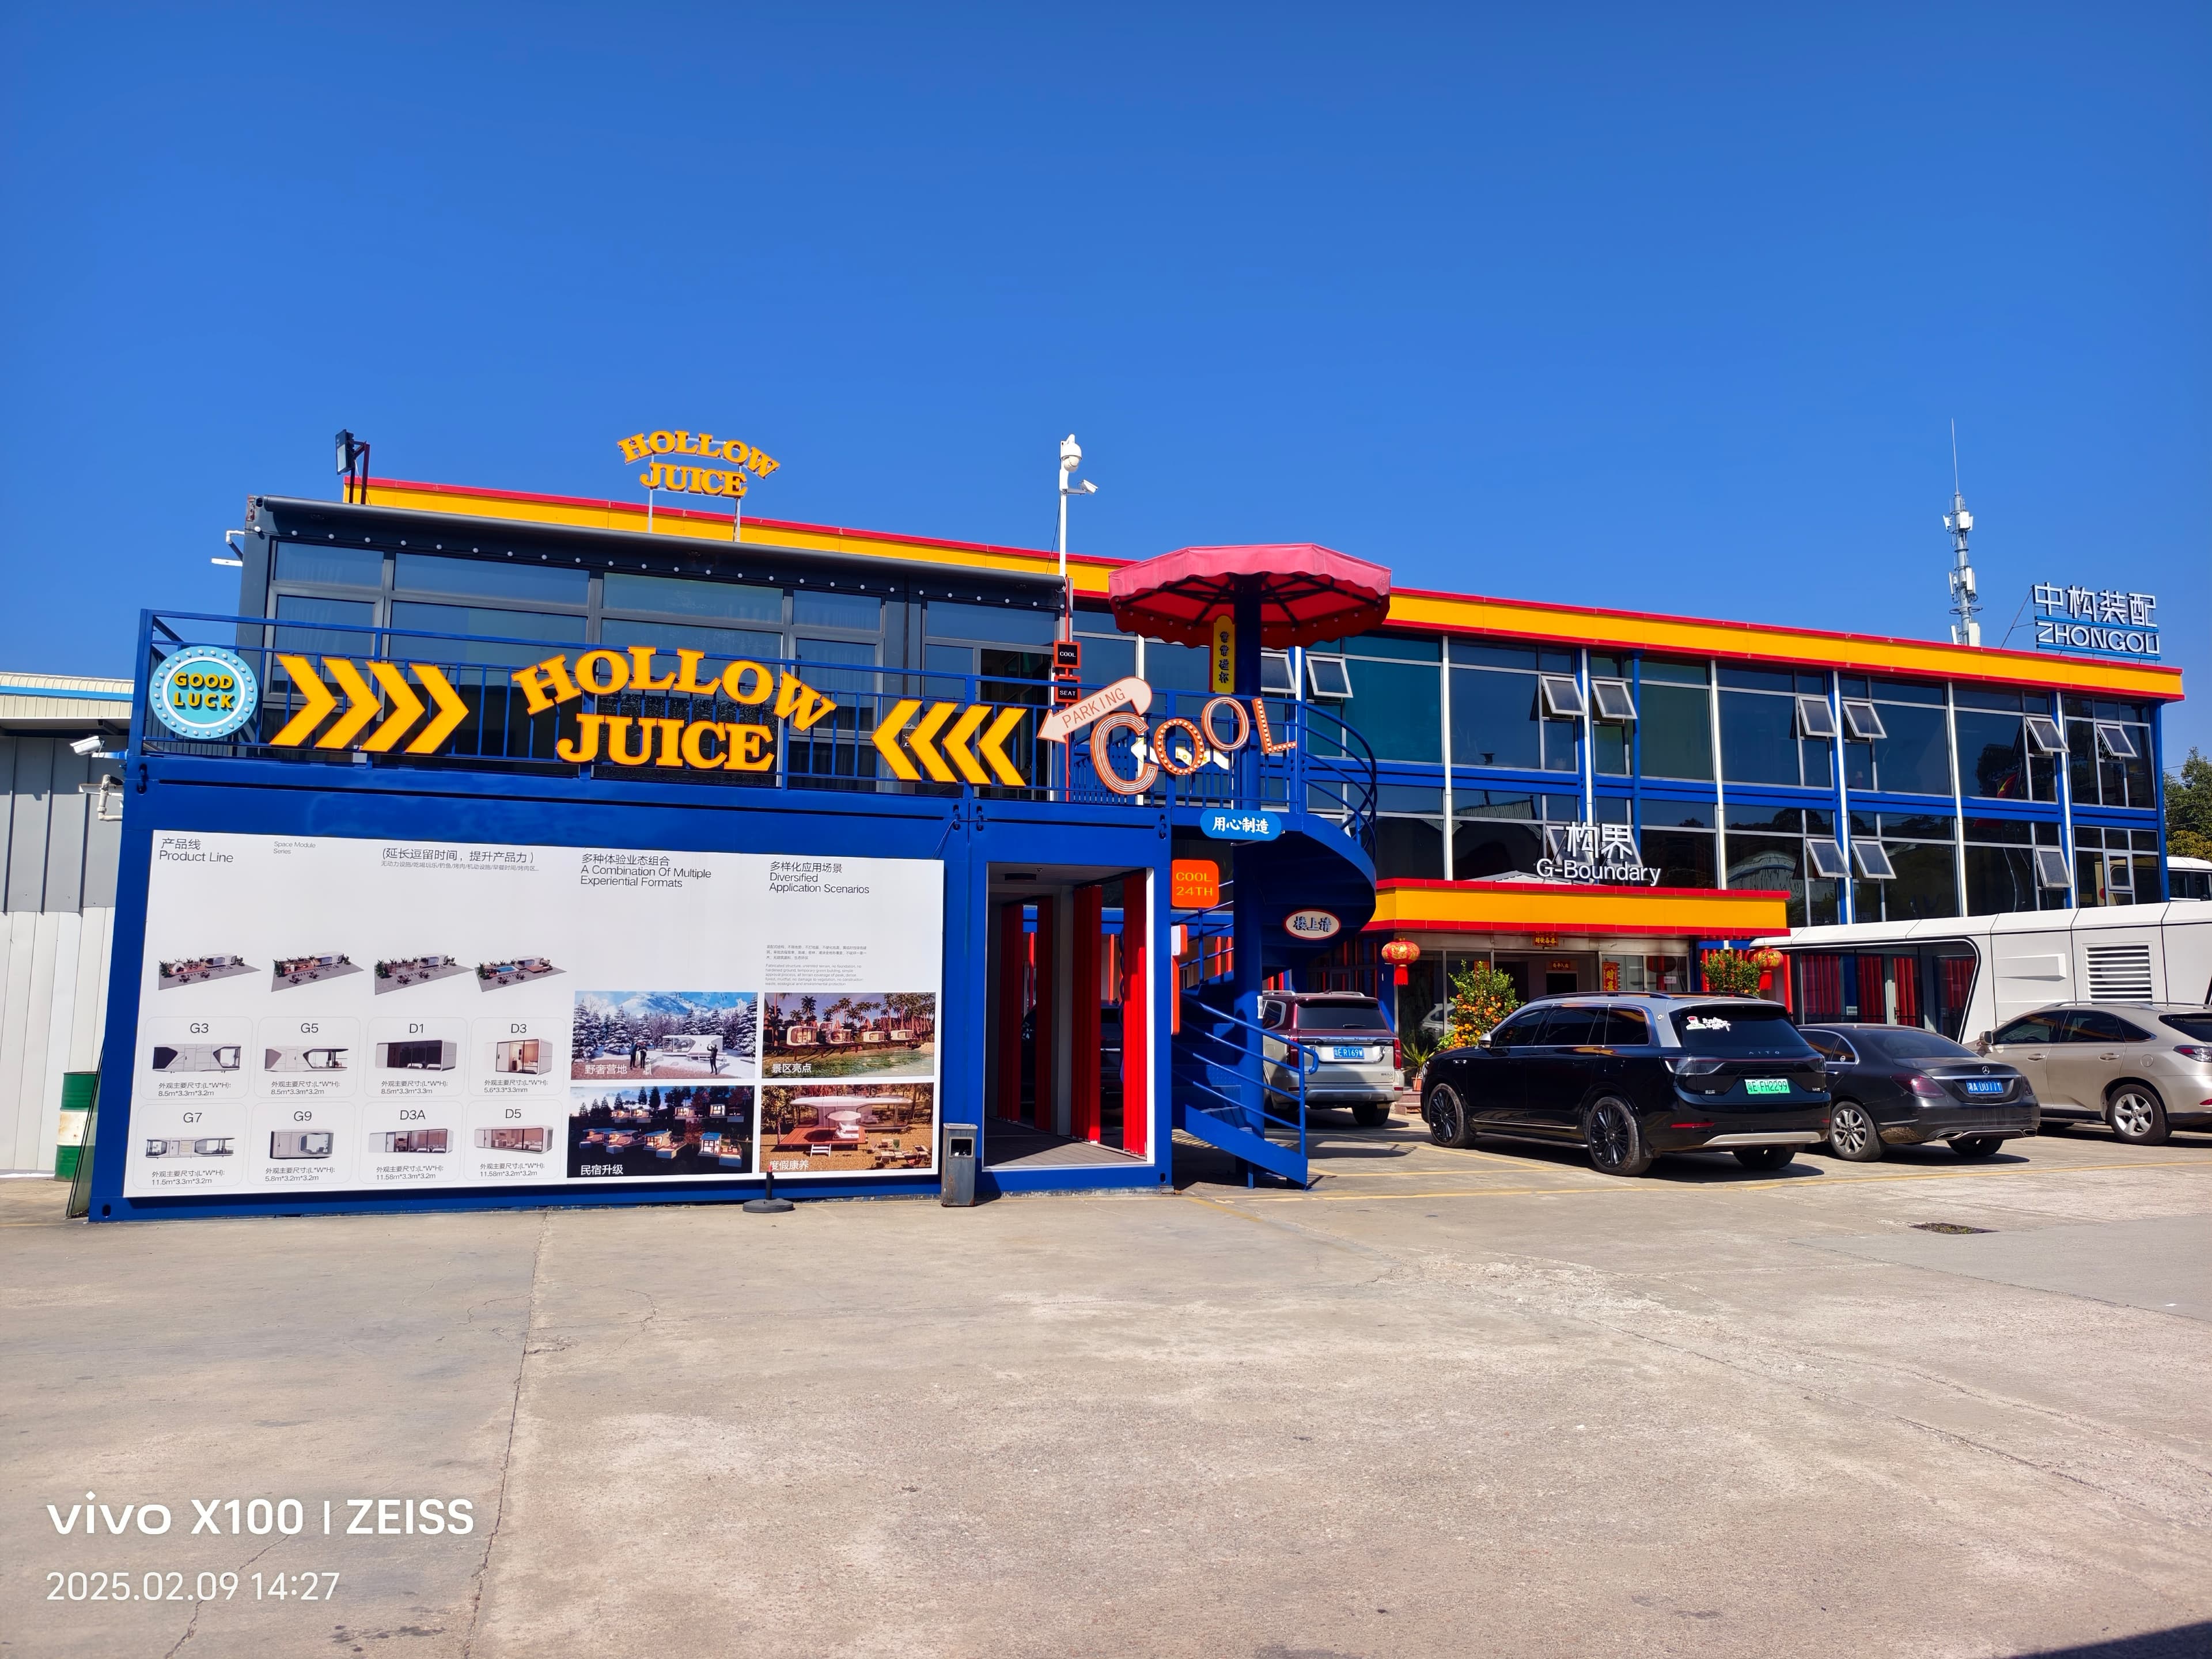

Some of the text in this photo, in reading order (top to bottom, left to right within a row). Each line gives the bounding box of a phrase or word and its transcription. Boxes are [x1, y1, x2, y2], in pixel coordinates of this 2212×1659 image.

[618, 430, 780, 479] HOLLOW
[639, 462, 748, 498] JUICE
[2033, 582, 2157, 627] 中构装配
[2036, 621, 2160, 654] ZHONGOU
[1218, 631, 1230, 684] 常常碰杯
[173, 672, 234, 690] GOOD
[511, 646, 838, 732] HOLLOW
[174, 694, 234, 709] LUCK
[1062, 687, 1126, 728] PARKING
[556, 713, 775, 771] JUICE
[1090, 698, 1297, 795] COOL
[1212, 816, 1270, 835] 用心制造
[160, 837, 201, 851] 产品线
[1567, 821, 1634, 859] 构界
[159, 850, 234, 863] Product Line
[580, 853, 672, 866] 多种体验业态组合
[579, 863, 713, 880] A Combination Of Multiple
[770, 860, 843, 873] 多样化应用场景
[1536, 858, 1662, 887] G-Boundary
[579, 875, 683, 888] Experiential Formats
[768, 872, 819, 883] Diversified
[1175, 872, 1213, 883] COOL
[768, 882, 870, 894] Application Scenarios
[1176, 887, 1213, 896] 24TH
[1293, 916, 1332, 932] 楼上请
[190, 1022, 209, 1034] G3
[300, 1022, 319, 1033] G5
[409, 1023, 423, 1033] D1
[511, 1023, 527, 1033] D3
[584, 1062, 628, 1075] 野奢营地
[771, 1062, 813, 1075] 景区亮点
[183, 1112, 203, 1123] G7
[293, 1111, 312, 1122] G9
[400, 1109, 426, 1120] D3A
[505, 1108, 521, 1119] D5
[580, 1162, 624, 1176] 民宿升级
[770, 1158, 810, 1171] 度假康养
